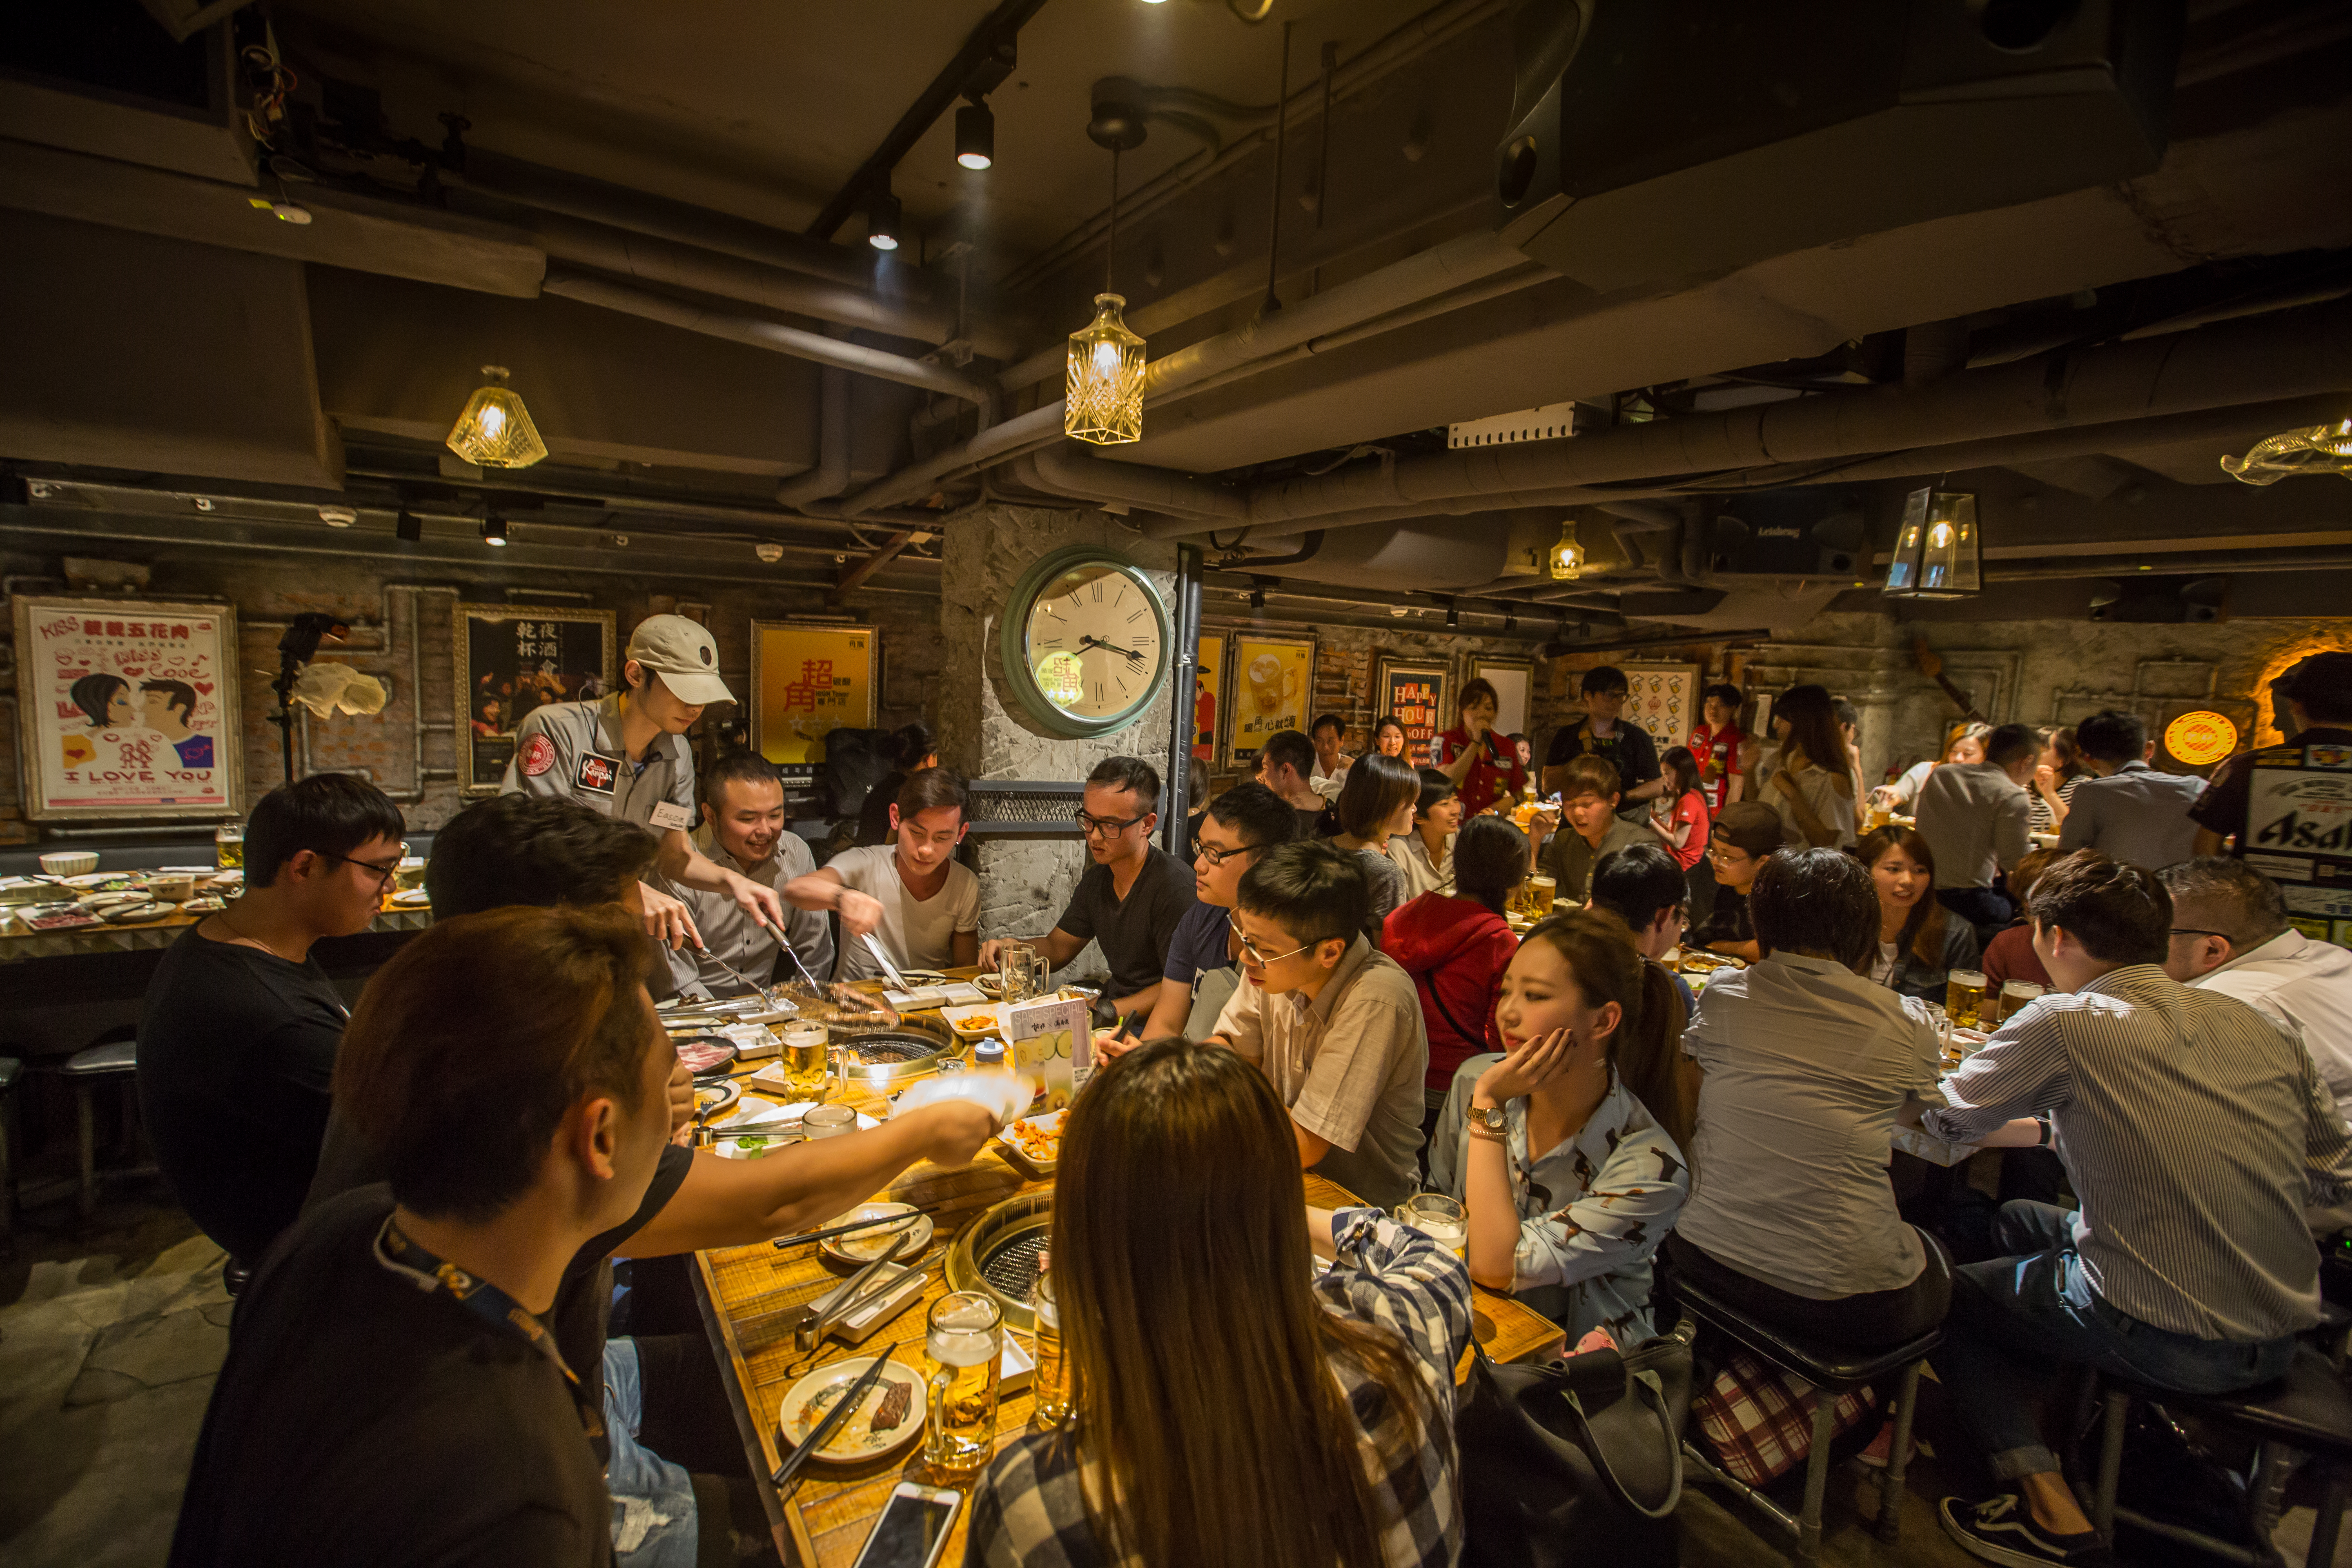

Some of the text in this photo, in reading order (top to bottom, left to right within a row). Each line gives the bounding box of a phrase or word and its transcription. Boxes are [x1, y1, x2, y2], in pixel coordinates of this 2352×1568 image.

[1394, 686, 1437, 706] HAPPY
[1394, 708, 1434, 724] HOUR
[65, 770, 211, 782] I LOVE YOU
[1014, 1009, 1041, 1025] SAKE
[1043, 1002, 1084, 1020] SPECIAL
